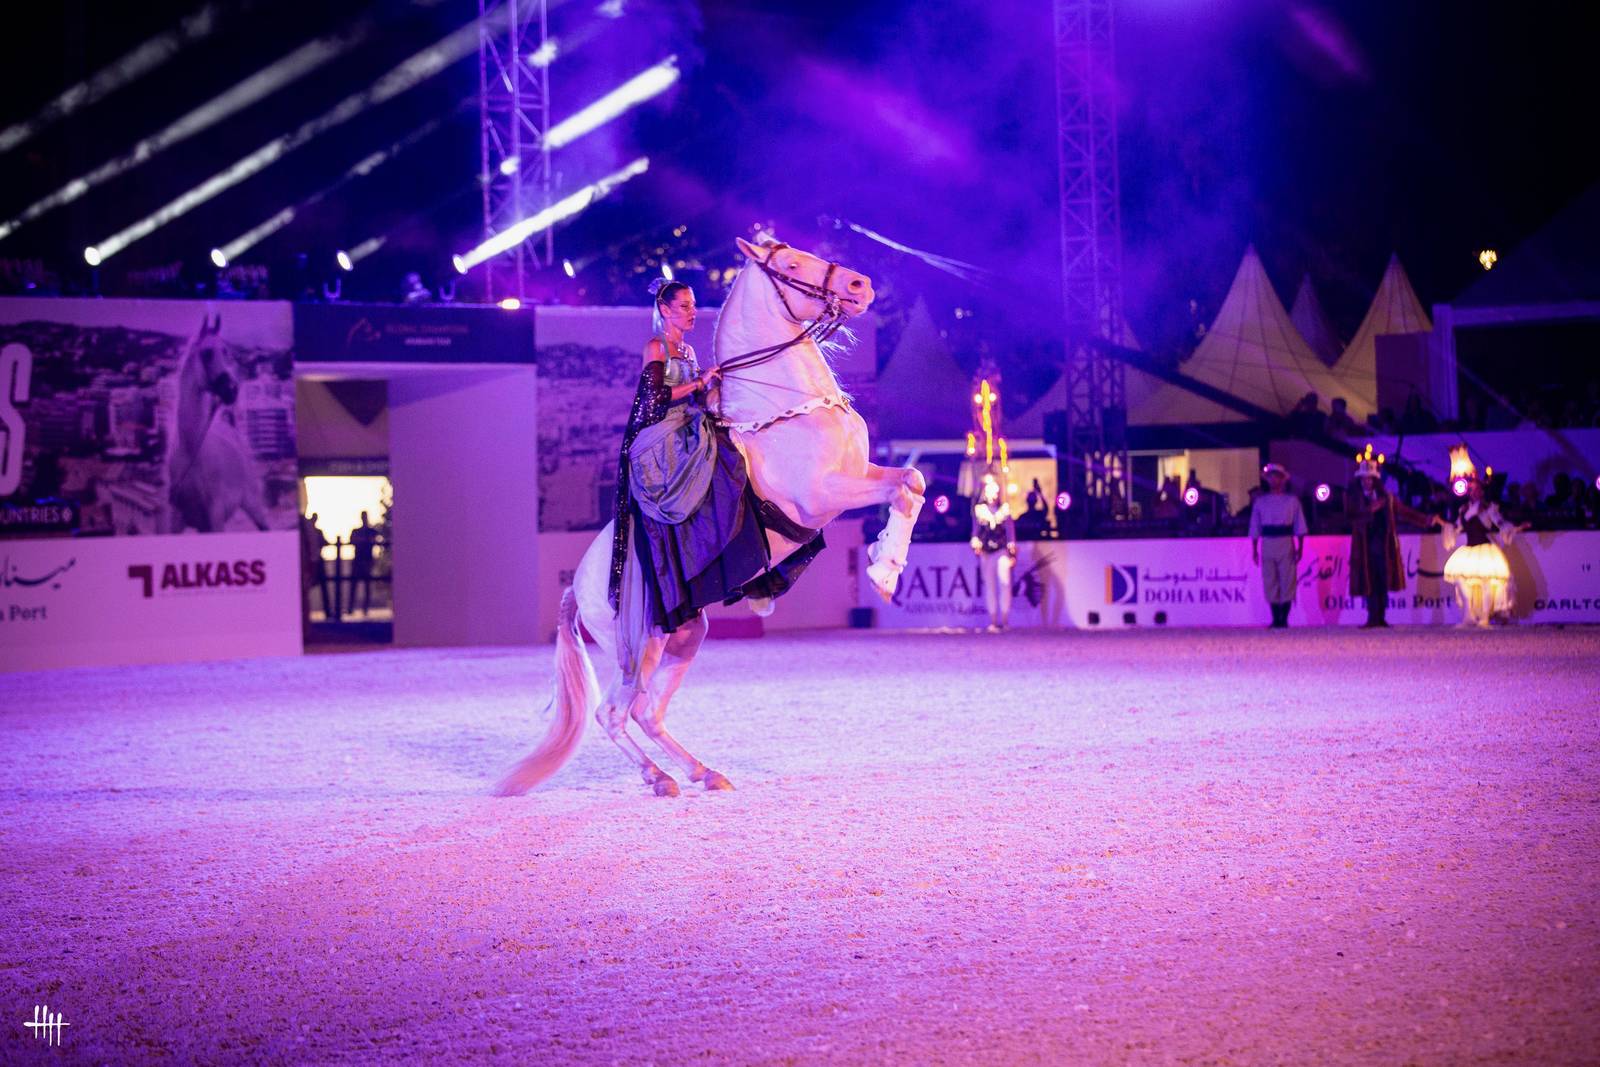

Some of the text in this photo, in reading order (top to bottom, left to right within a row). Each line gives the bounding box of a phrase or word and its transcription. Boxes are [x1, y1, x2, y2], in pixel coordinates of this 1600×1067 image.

[161, 560, 266, 589] ALKASS
[1144, 587, 1246, 604] DOHA BANK
[1413, 594, 1451, 609] Port
[10, 604, 48, 621] Port
